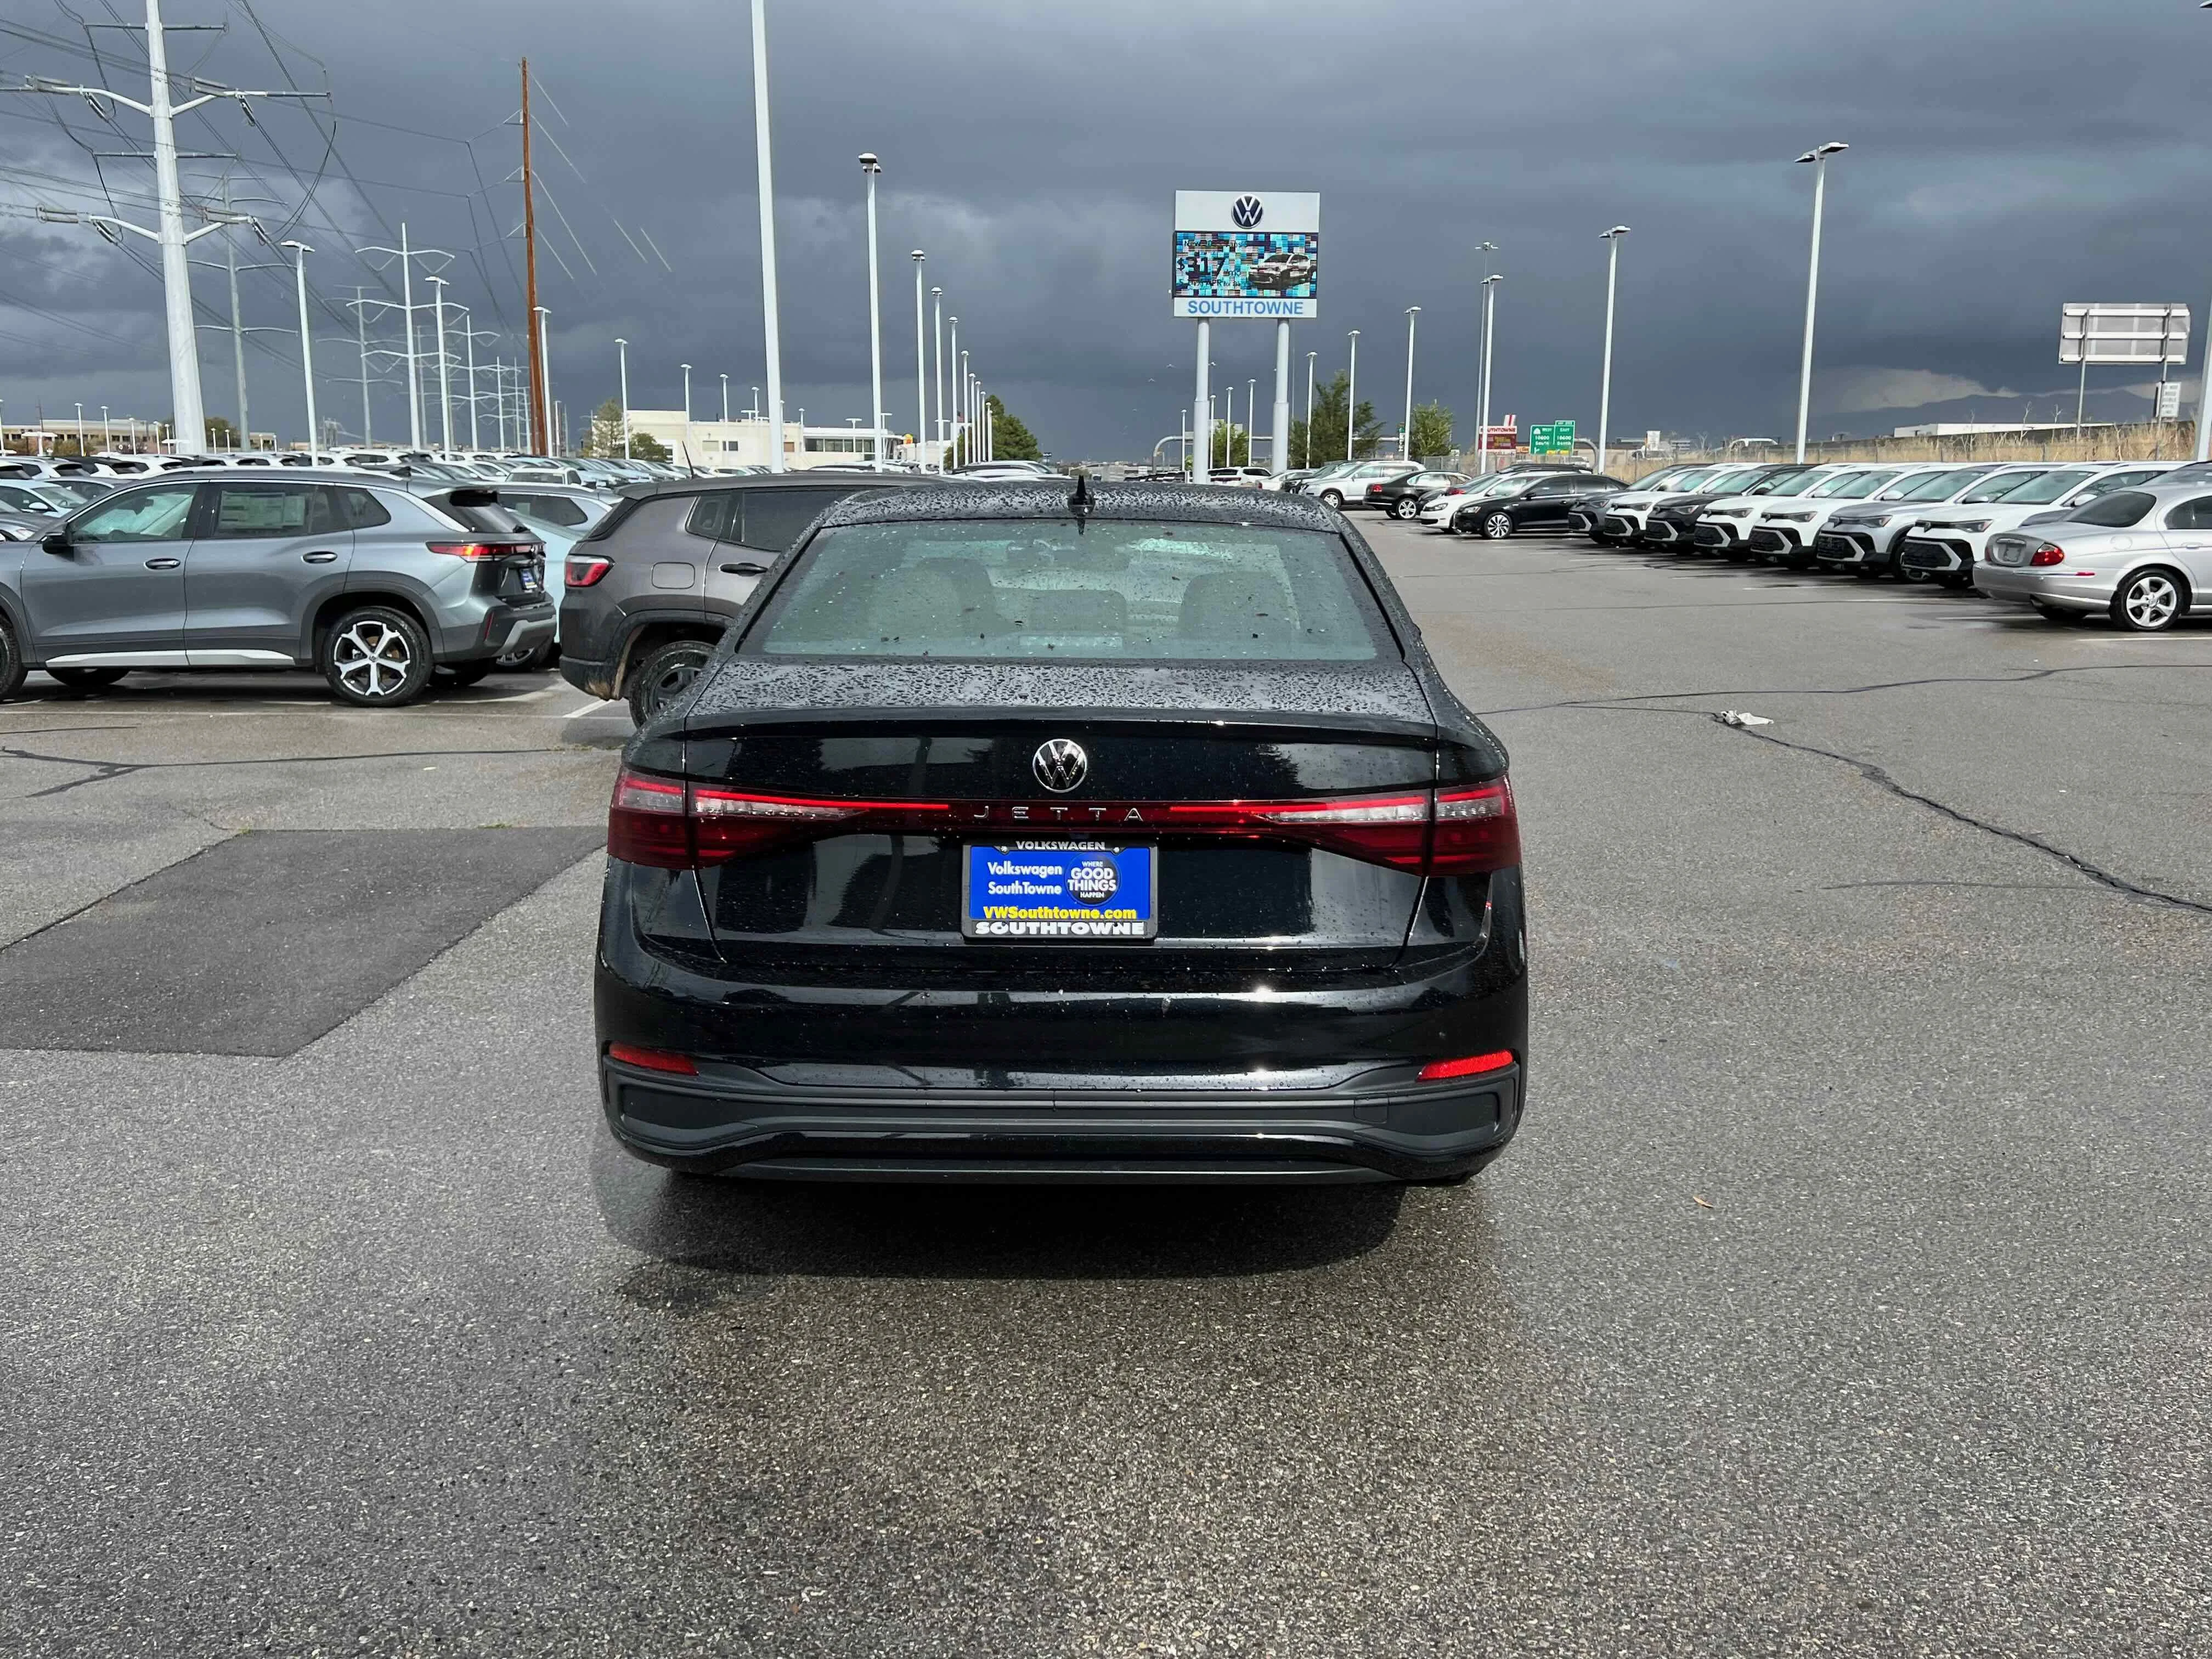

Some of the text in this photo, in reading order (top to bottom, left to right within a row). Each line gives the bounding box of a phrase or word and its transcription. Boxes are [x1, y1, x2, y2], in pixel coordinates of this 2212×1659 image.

[1188, 301, 1304, 314] SOUTHTOWNE
[974, 805, 1143, 822] JETTA
[1015, 841, 1105, 850] VOLKSWAGEN
[988, 861, 1063, 878] Volkswagen
[1071, 867, 1114, 879] GOOD
[988, 880, 1062, 895] SouthTowne
[1068, 879, 1117, 891] THINGS
[983, 906, 1137, 919] VWSouthtowne.com
[975, 922, 1144, 935] SOUTHTOWNE
